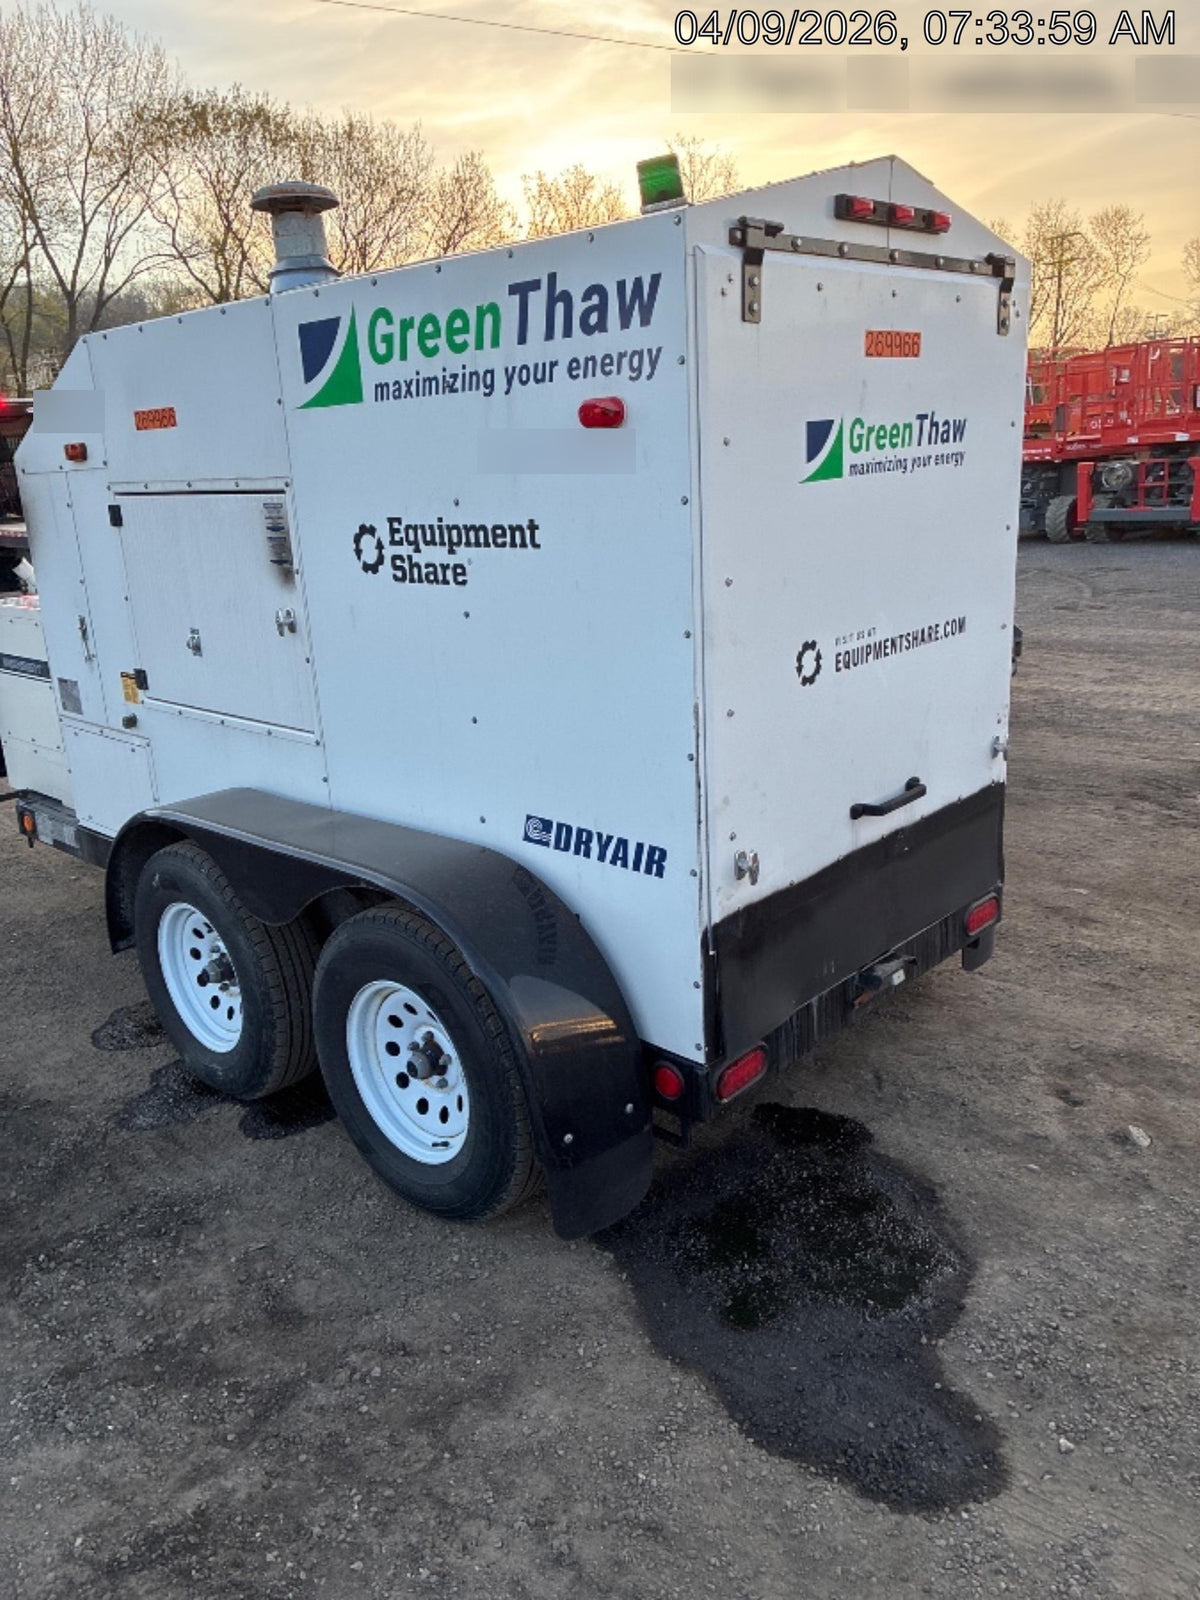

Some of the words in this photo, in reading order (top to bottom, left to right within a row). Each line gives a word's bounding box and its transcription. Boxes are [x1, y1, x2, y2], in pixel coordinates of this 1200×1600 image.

[367, 271, 663, 366] GreenThaw
[865, 331, 921, 357] 269966
[374, 364, 495, 402] maximizing
[503, 358, 559, 396] your
[566, 346, 663, 381] energy
[849, 411, 967, 453] GreenThaw
[848, 455, 908, 477] maximizing
[910, 454, 932, 474] your
[934, 451, 966, 468] energy
[386, 516, 542, 555] Equipment
[390, 554, 469, 587] Share
[835, 632, 854, 646] VIST
[835, 616, 966, 673] EQUIPMENTSHARE.COM
[553, 822, 667, 878] DRYAIR
